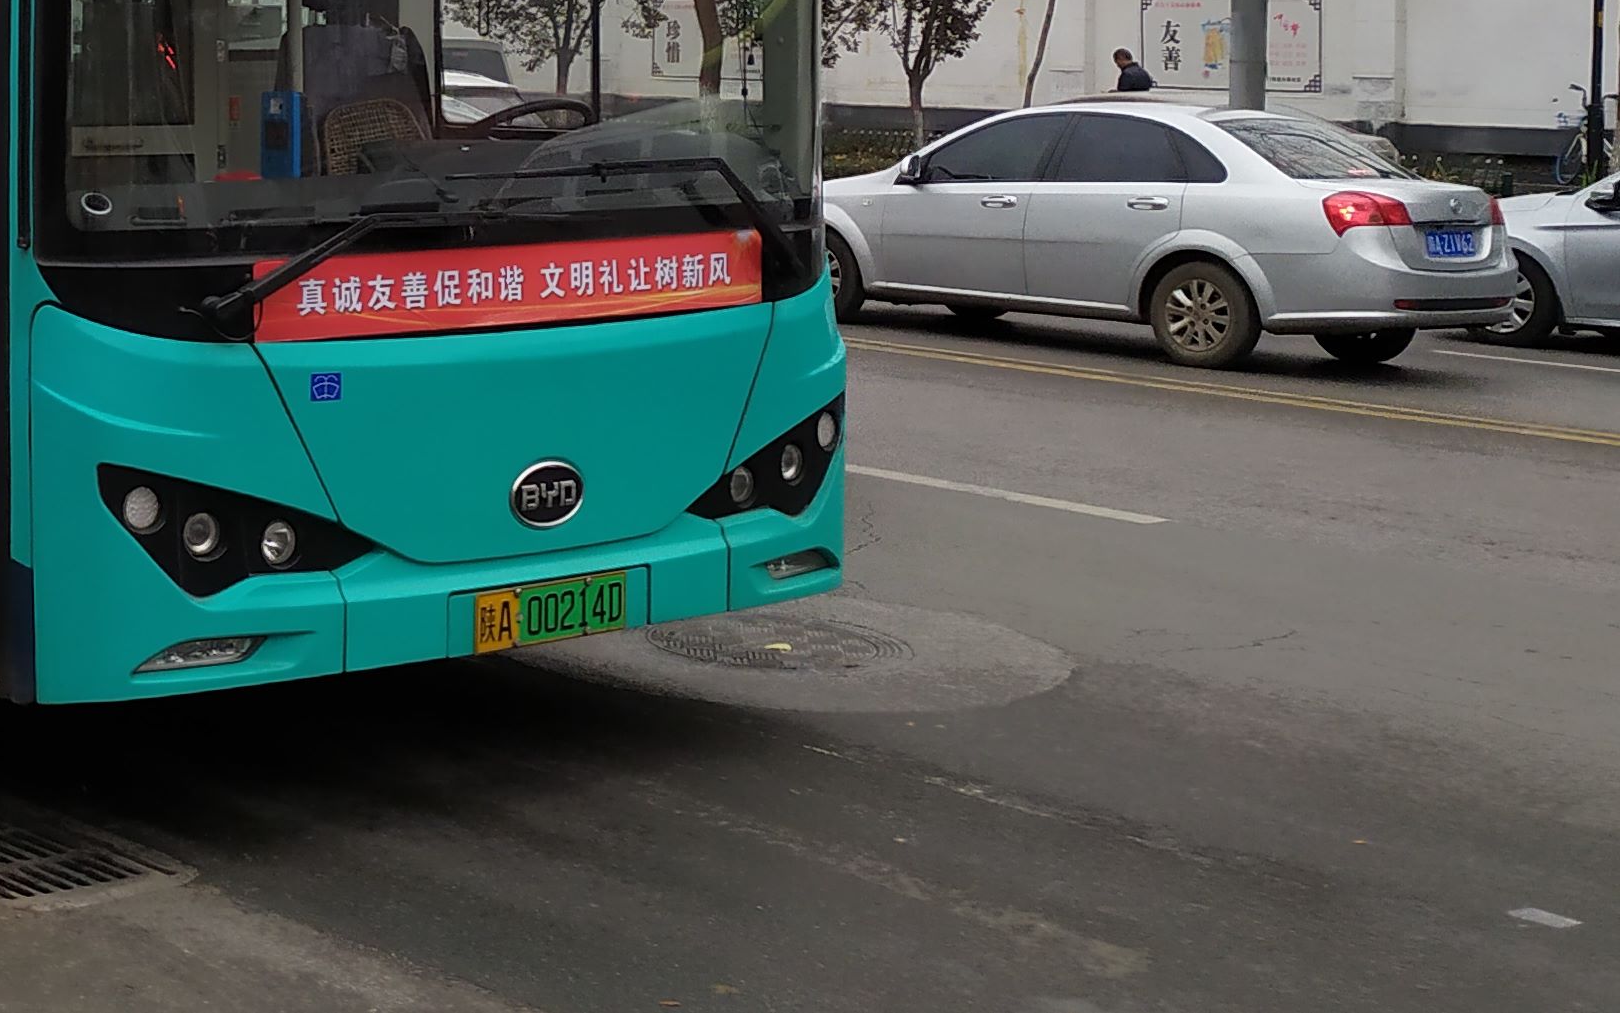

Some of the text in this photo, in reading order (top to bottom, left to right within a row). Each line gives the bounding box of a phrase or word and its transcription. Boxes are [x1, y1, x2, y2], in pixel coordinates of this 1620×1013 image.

[1160, 20, 1182, 71] 友善
[297, 251, 732, 317] 真诚友善促和谐 文明礼让树新风
[520, 478, 578, 511] BYD
